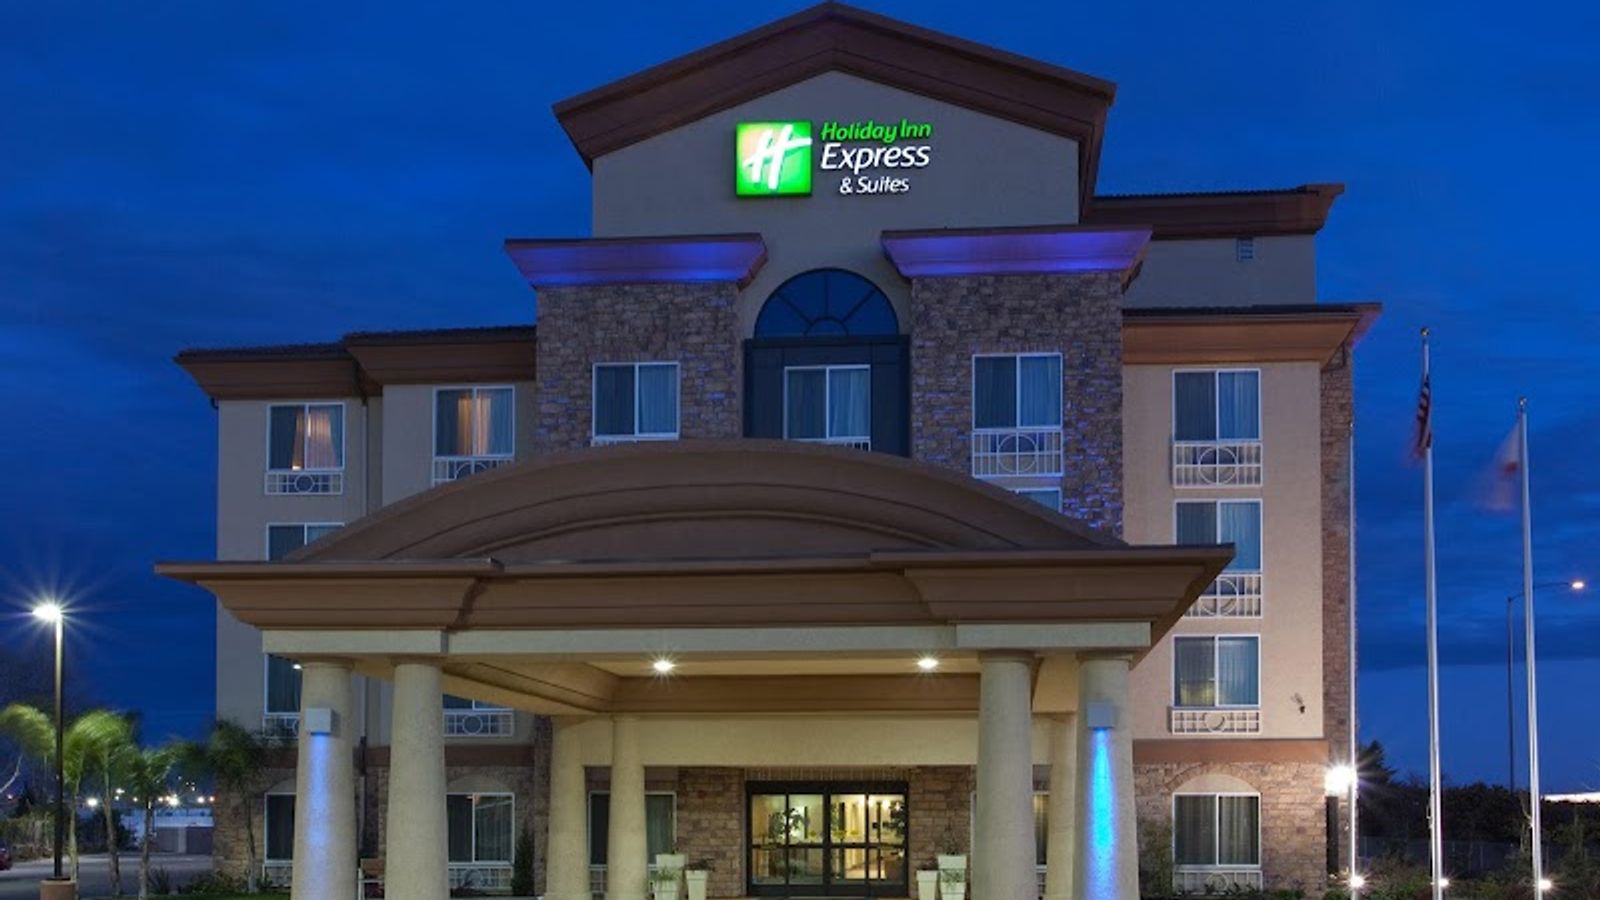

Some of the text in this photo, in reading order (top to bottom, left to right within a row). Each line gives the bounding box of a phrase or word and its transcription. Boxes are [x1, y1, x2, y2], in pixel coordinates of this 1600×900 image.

[821, 119, 931, 143] Holiday Inn
[820, 142, 931, 175] Express
[840, 175, 909, 194] & Suites
